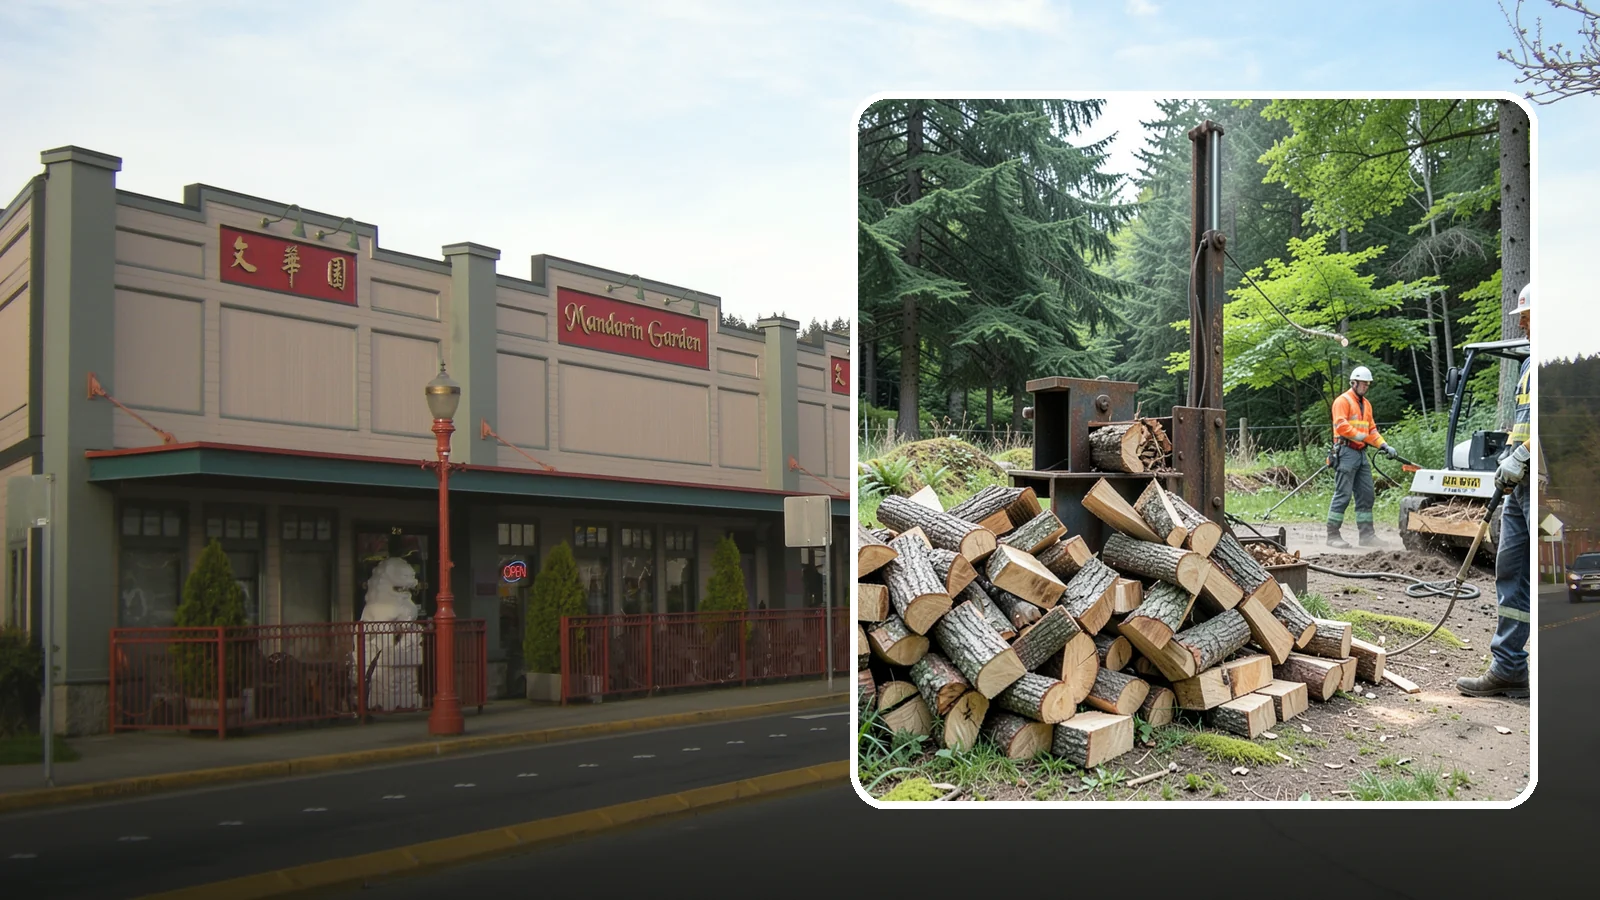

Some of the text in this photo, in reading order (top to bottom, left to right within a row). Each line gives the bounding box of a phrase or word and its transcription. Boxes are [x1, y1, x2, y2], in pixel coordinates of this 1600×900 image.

[230, 235, 347, 291] 文華園
[564, 302, 701, 353] Mandarin Garden
[503, 565, 527, 578] OPEN
